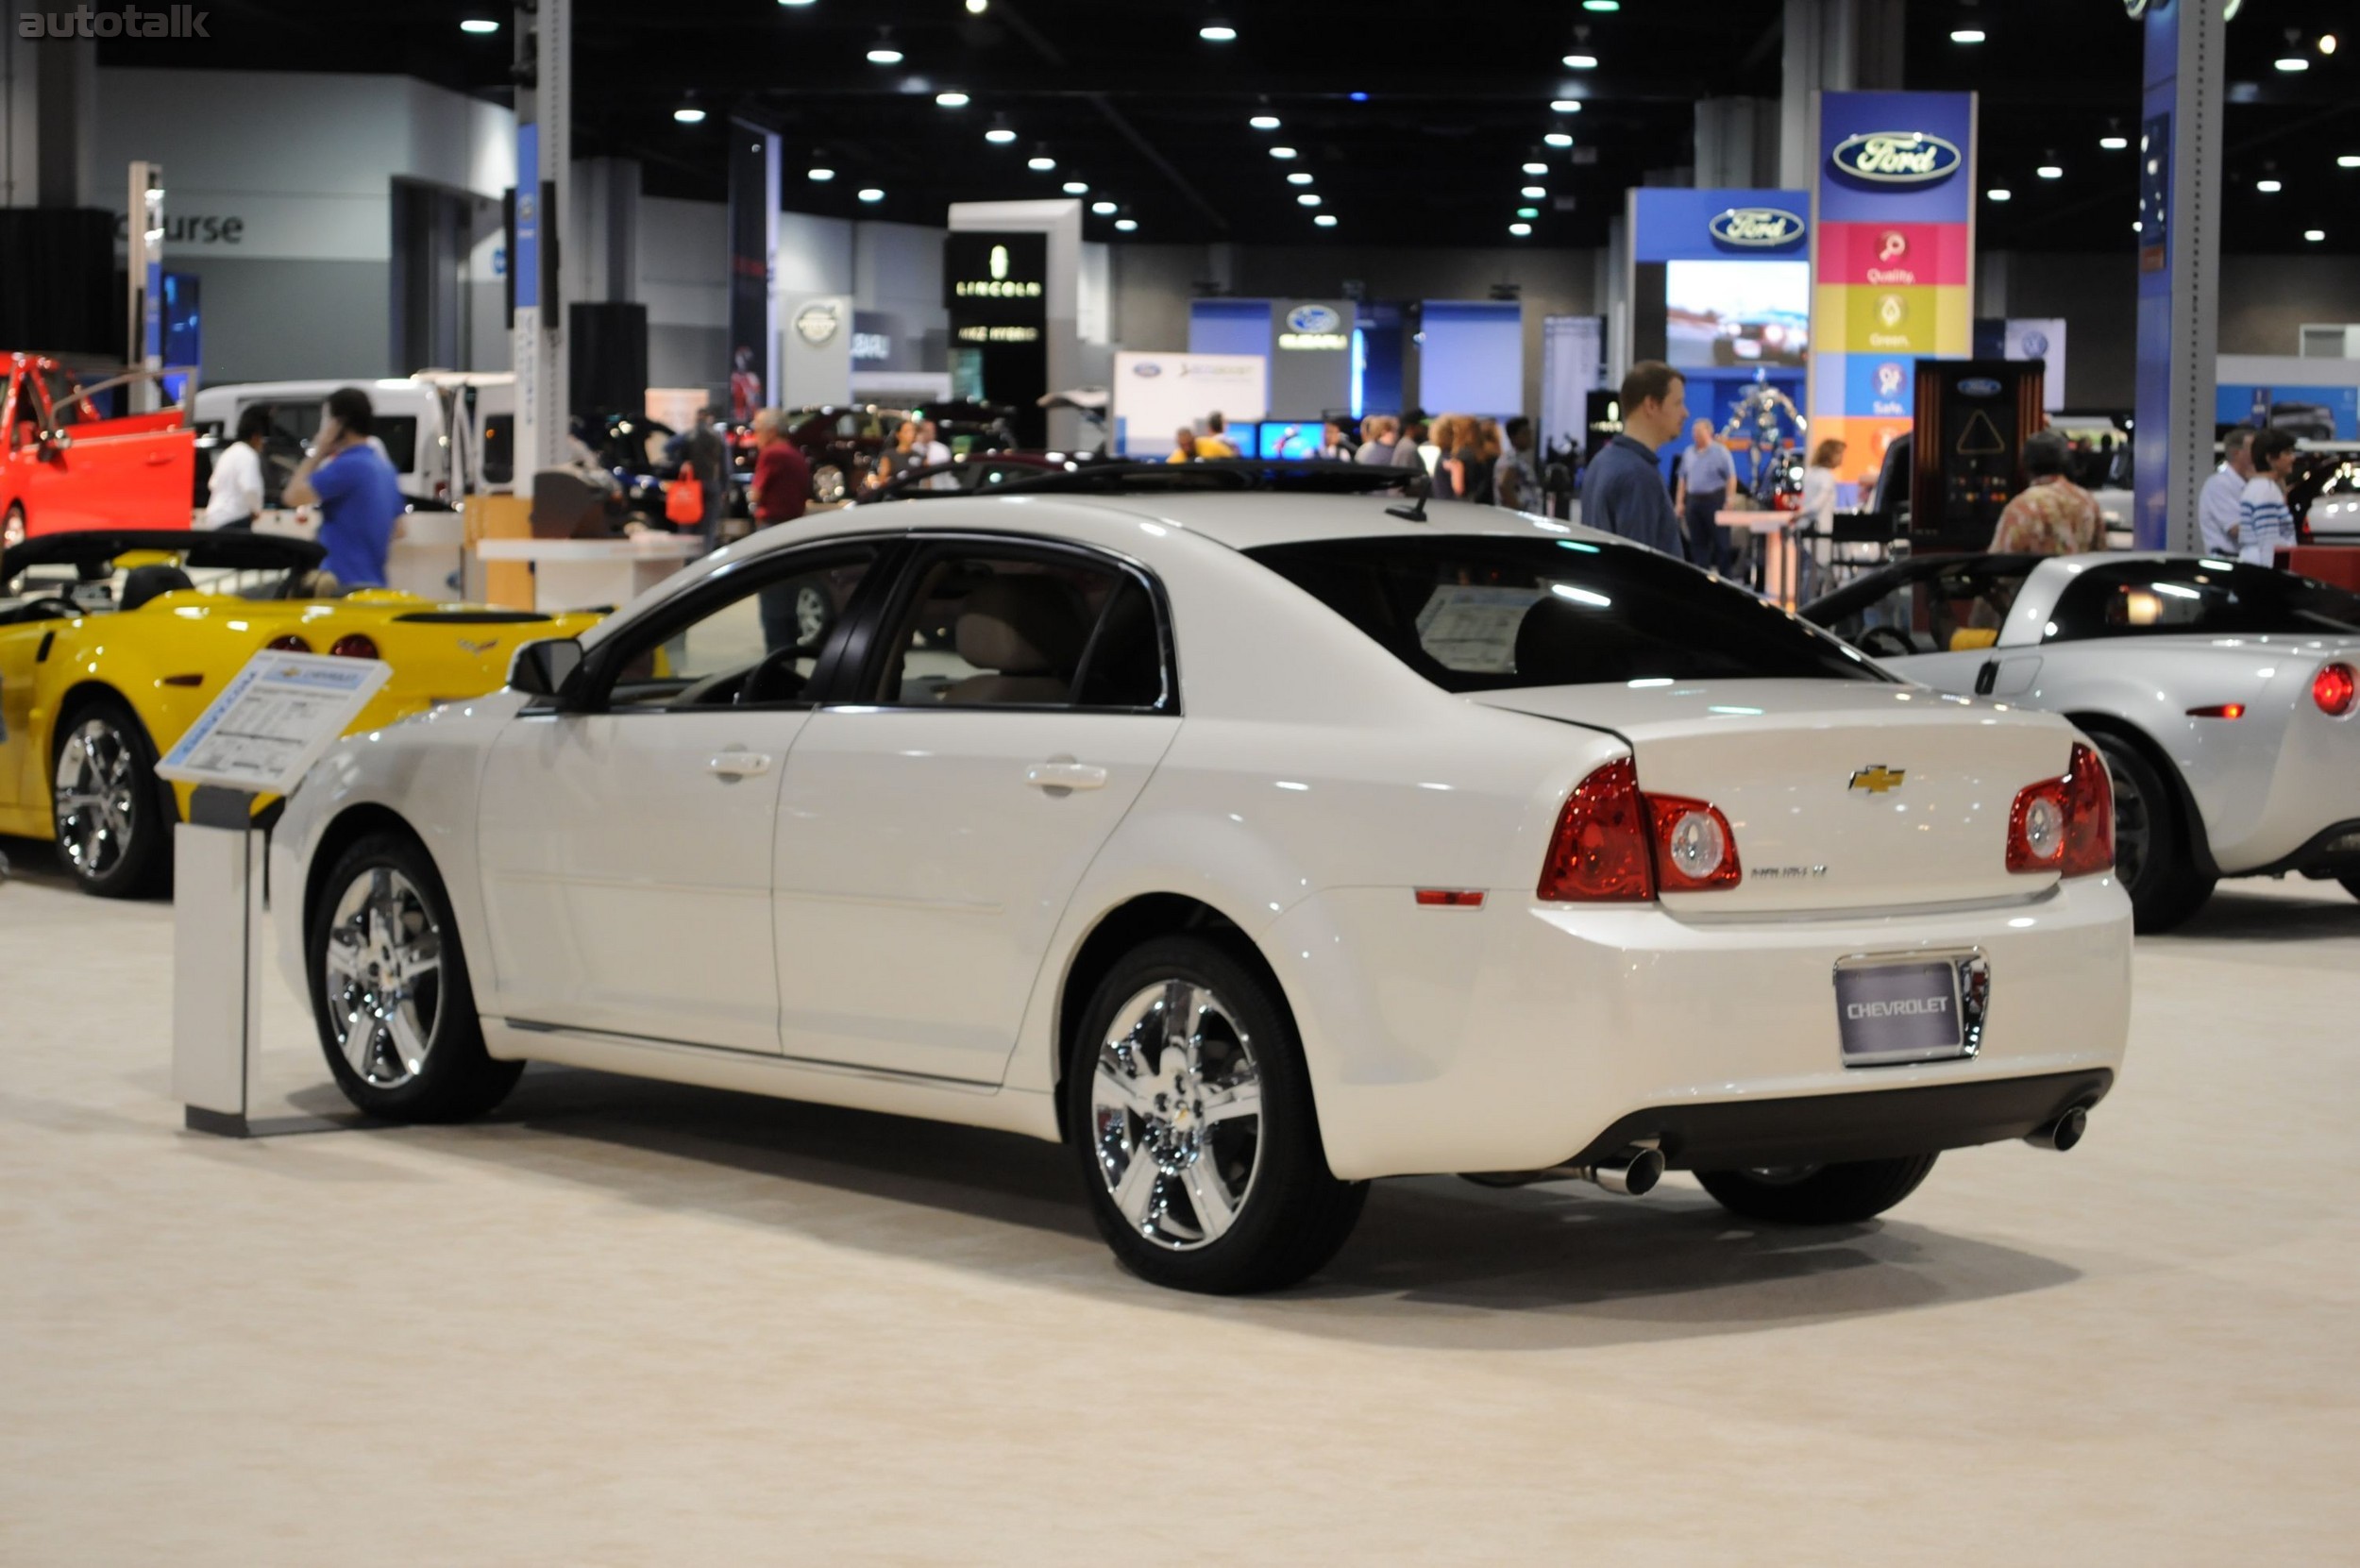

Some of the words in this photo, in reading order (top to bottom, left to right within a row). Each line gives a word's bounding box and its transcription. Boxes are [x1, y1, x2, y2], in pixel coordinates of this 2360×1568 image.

[1857, 138, 1937, 173] Ford
[1727, 212, 1787, 240] Ford
[956, 281, 1041, 297] LINCOLN
[1847, 996, 1948, 1020] CHEVROLET
